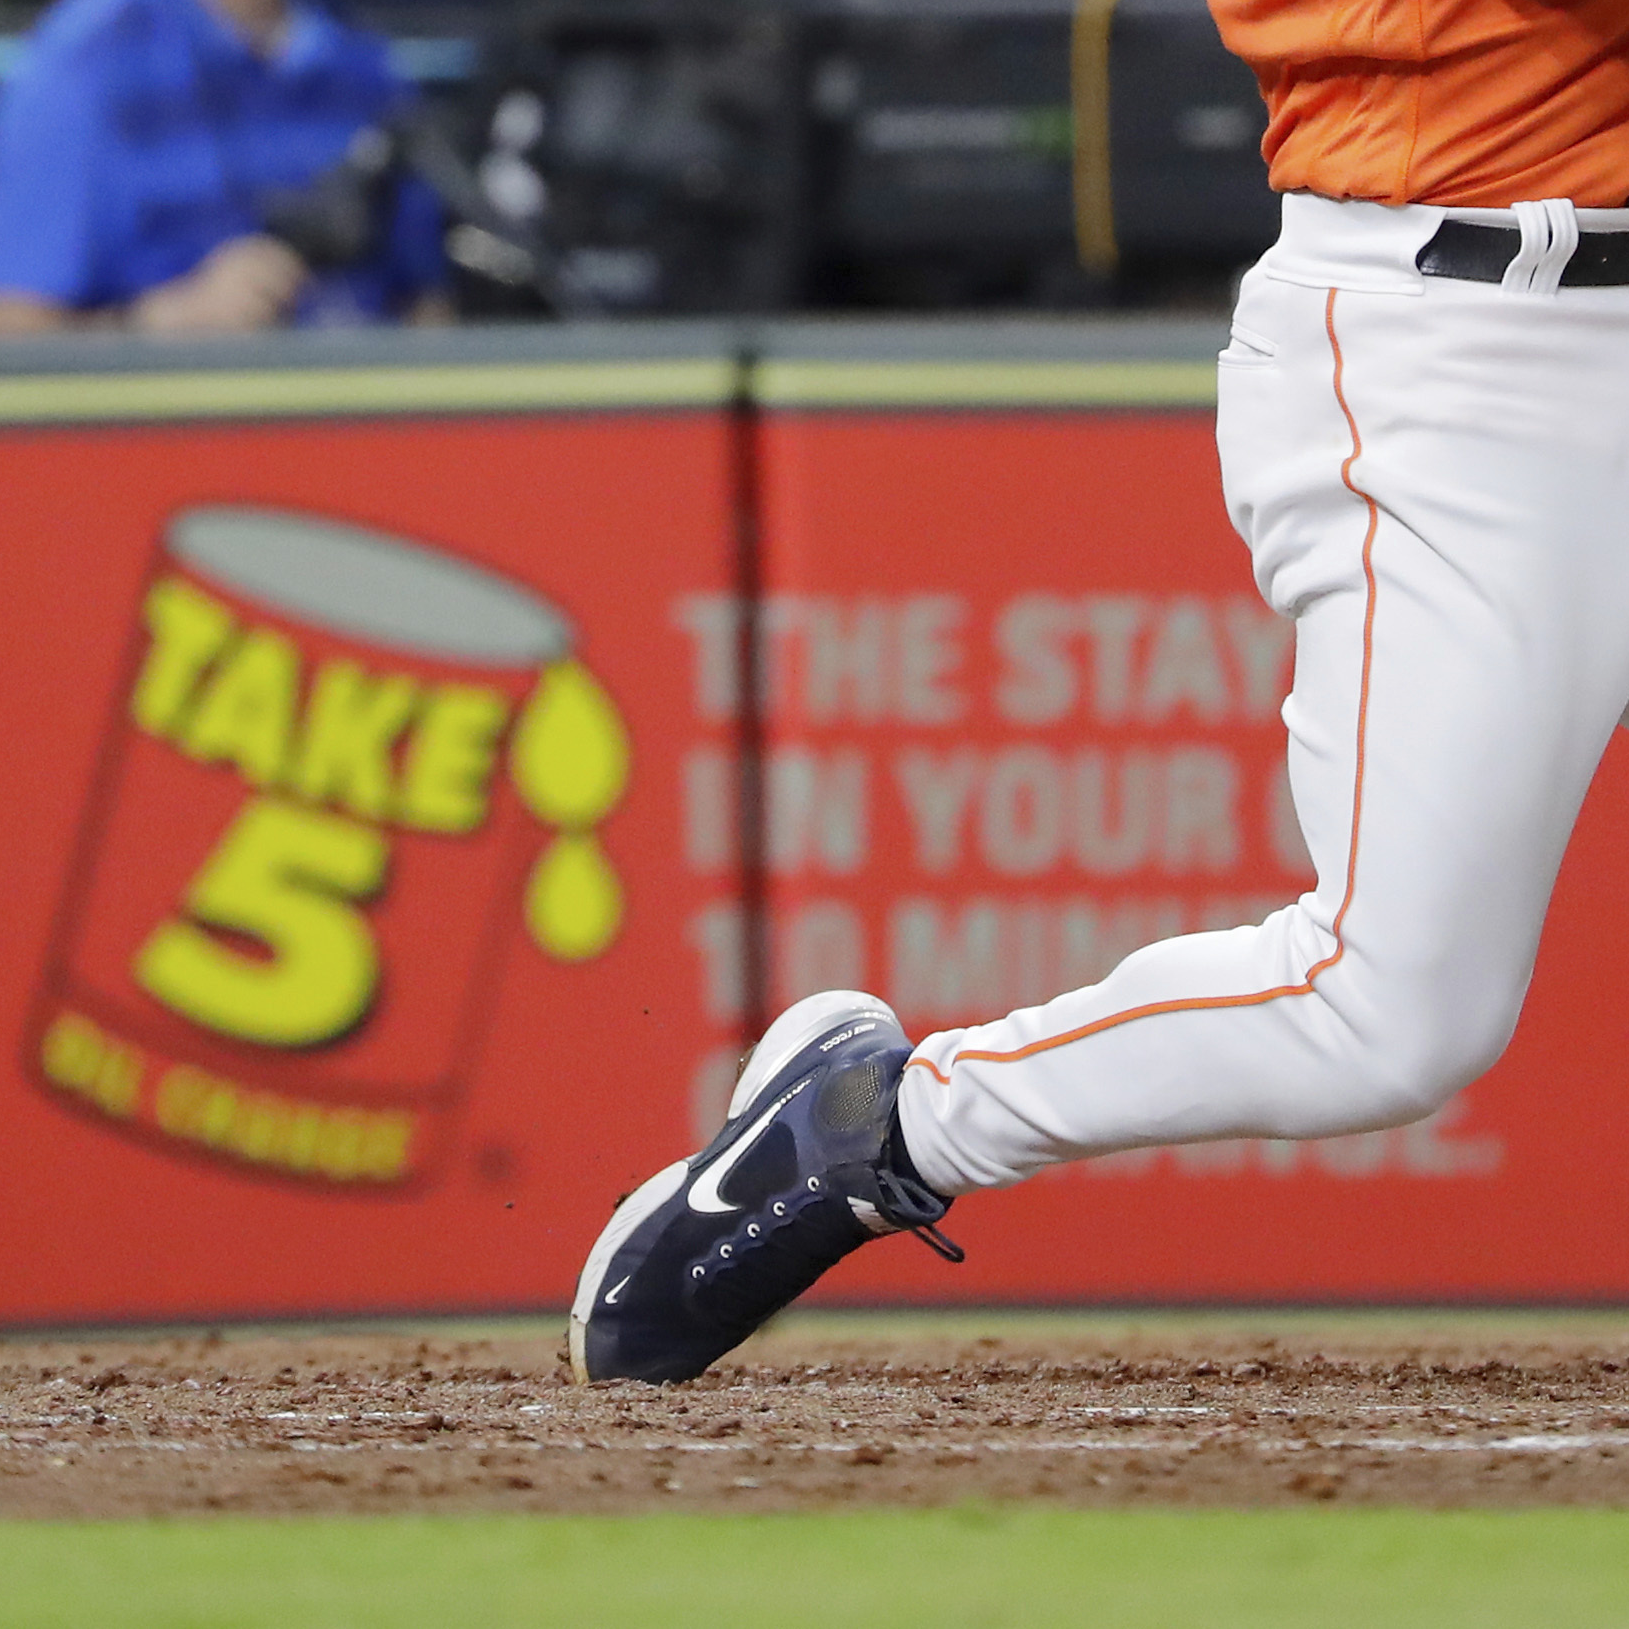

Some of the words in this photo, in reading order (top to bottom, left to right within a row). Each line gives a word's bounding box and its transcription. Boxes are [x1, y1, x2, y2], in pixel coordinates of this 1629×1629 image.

[130, 577, 510, 834] TAKE
[895, 744, 1242, 870] YOUR
[132, 794, 394, 1048] 5
